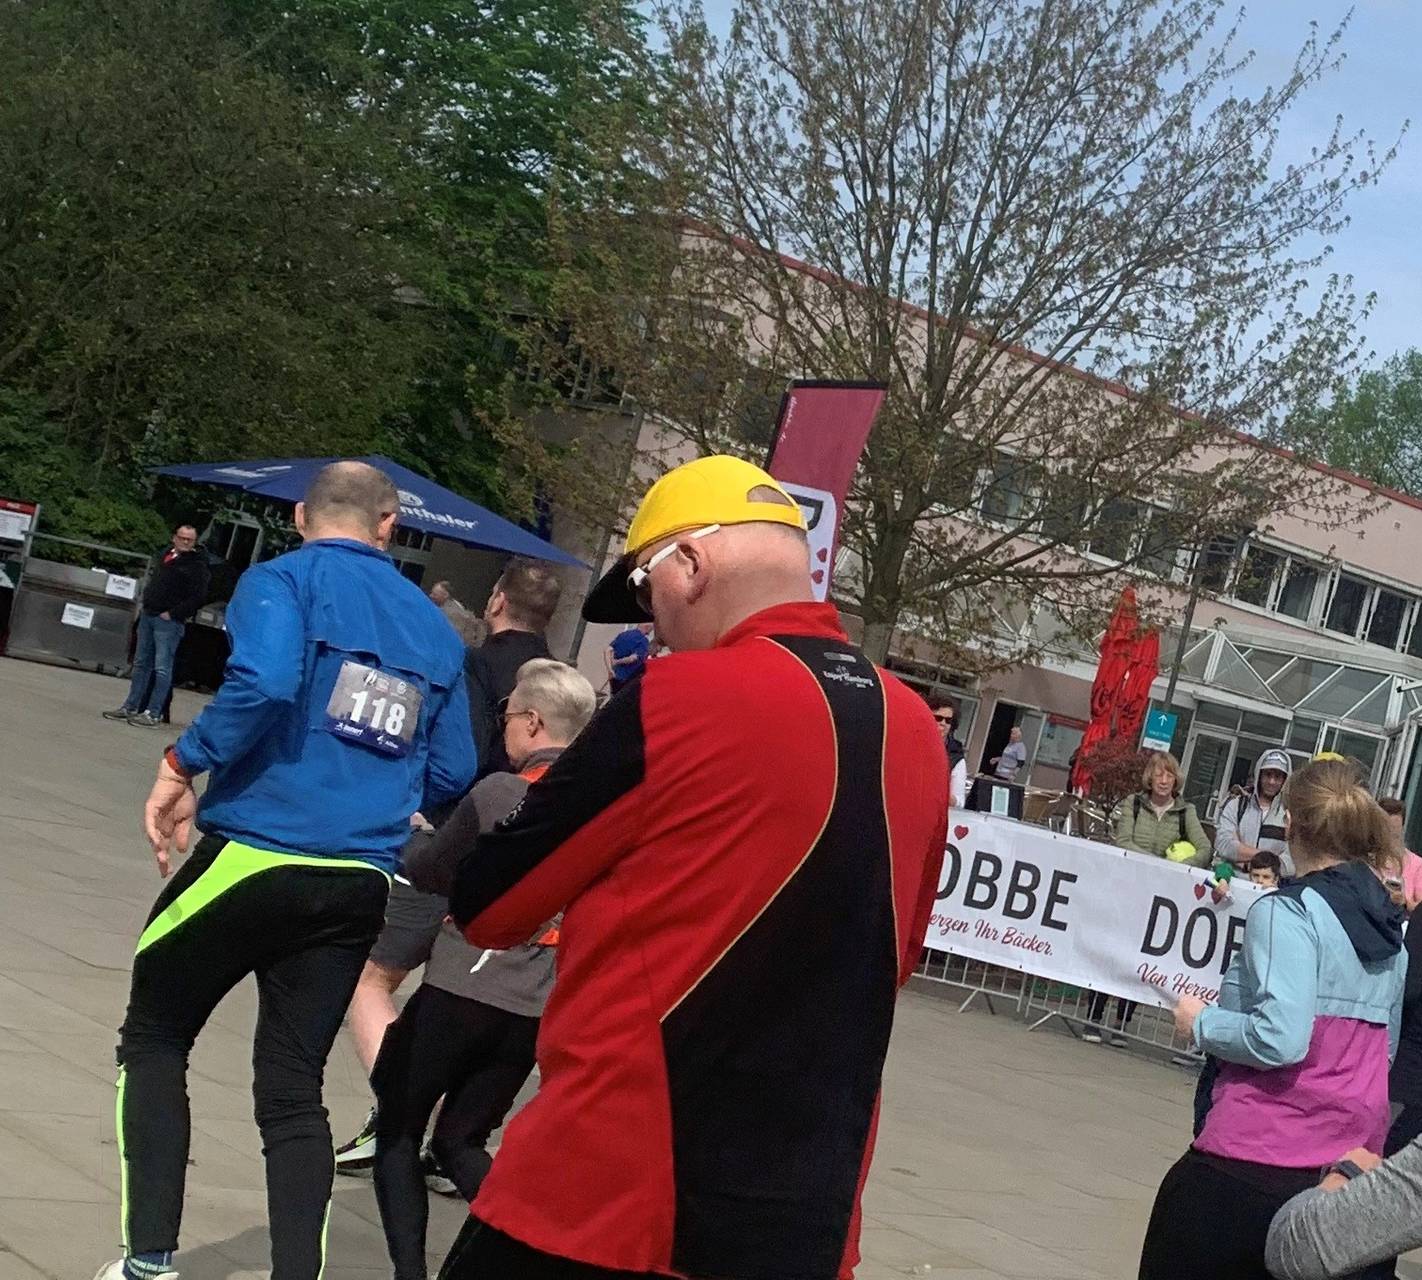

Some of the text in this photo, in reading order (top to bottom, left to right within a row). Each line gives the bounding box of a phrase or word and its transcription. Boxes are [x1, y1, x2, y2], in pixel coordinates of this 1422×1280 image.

[350, 690, 406, 736] 118
[974, 918, 1000, 941] Ihr
[1001, 926, 1054, 956] Bäcker.
[1136, 962, 1168, 988] Von
